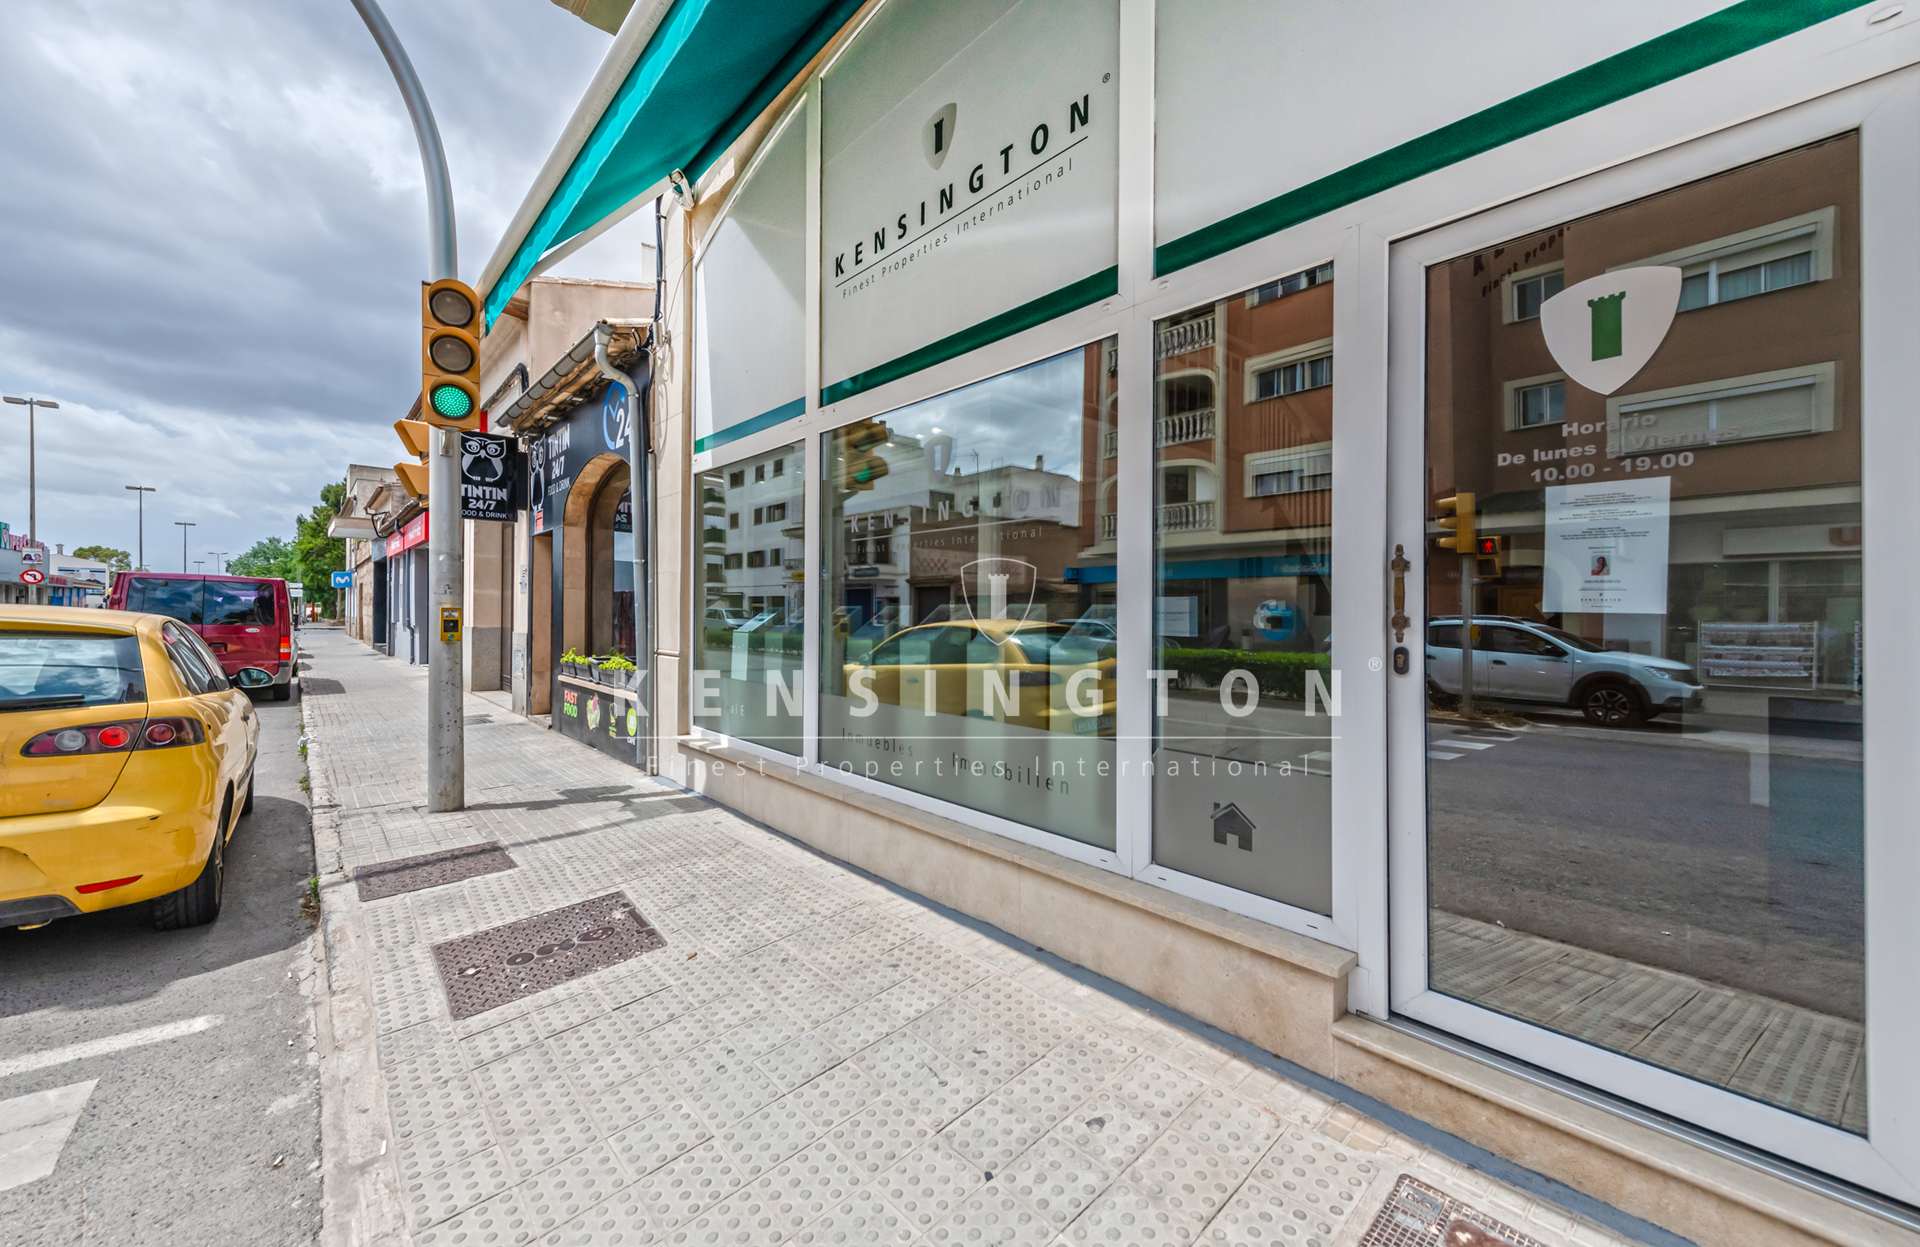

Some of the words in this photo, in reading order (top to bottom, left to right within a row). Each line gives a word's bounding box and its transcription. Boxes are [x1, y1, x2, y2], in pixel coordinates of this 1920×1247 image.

[835, 93, 1089, 278] KENSINGTON
[843, 273, 875, 299] Finest
[882, 232, 949, 277] Properties
[957, 157, 1073, 235] International
[1562, 413, 1657, 437] Horario
[548, 423, 571, 459] TINTIN
[1497, 453, 1526, 466] De
[1533, 444, 1597, 461] lunes
[1605, 442, 1619, 453] a
[1630, 424, 1742, 450] Viernes
[551, 455, 565, 479] 24/7
[1530, 463, 1595, 483] 10.00
[1620, 451, 1695, 473] 19.00
[461, 484, 508, 501] TINTIN
[468, 498, 497, 511] 24/7
[485, 511, 508, 519] DRINK
[564, 689, 578, 704] FAST
[564, 702, 578, 718] FOOD
[842, 728, 913, 757] Inmuebles
[952, 752, 1069, 795] Immobilien
